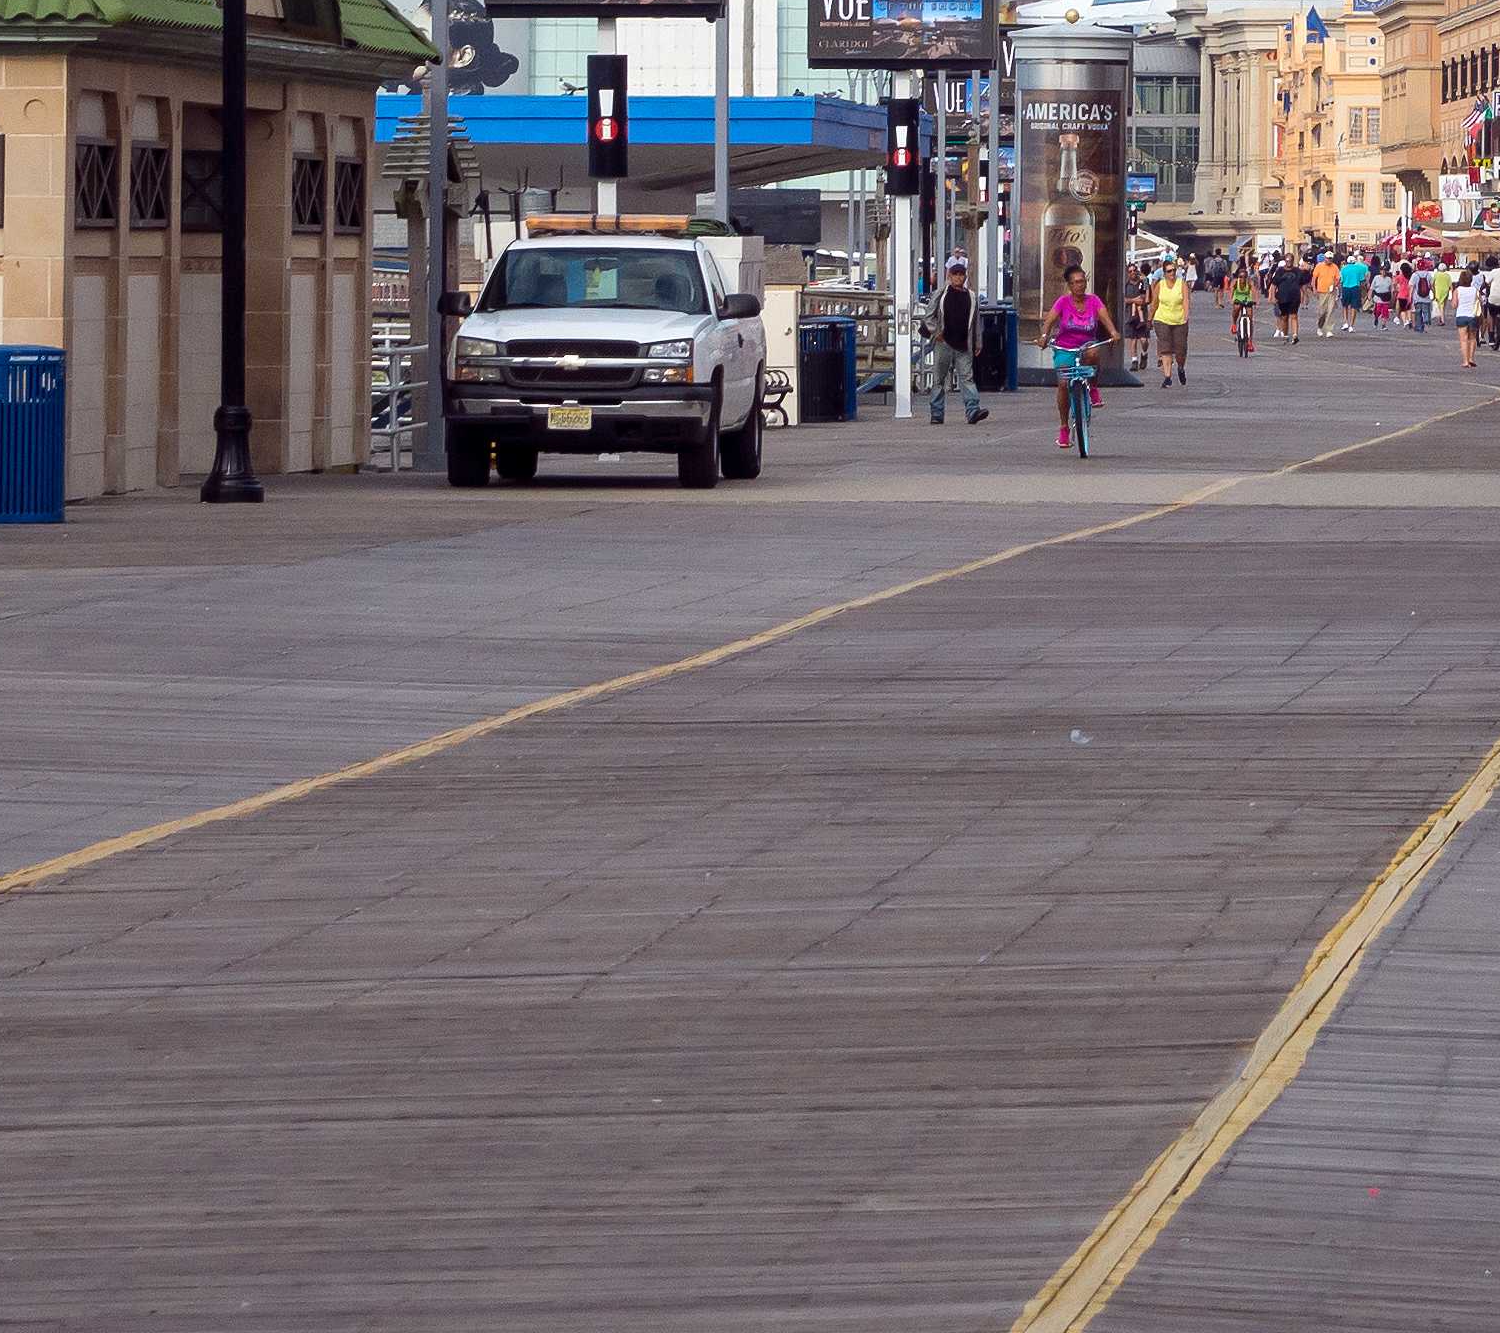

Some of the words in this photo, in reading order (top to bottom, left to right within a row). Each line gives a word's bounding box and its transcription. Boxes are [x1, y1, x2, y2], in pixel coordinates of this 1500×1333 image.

[1025, 102, 1113, 121] AMERICA'S
[1030, 122, 1060, 131] ORIGINAL
[1062, 122, 1085, 131] CRAFT
[1087, 122, 1109, 131] VODKA
